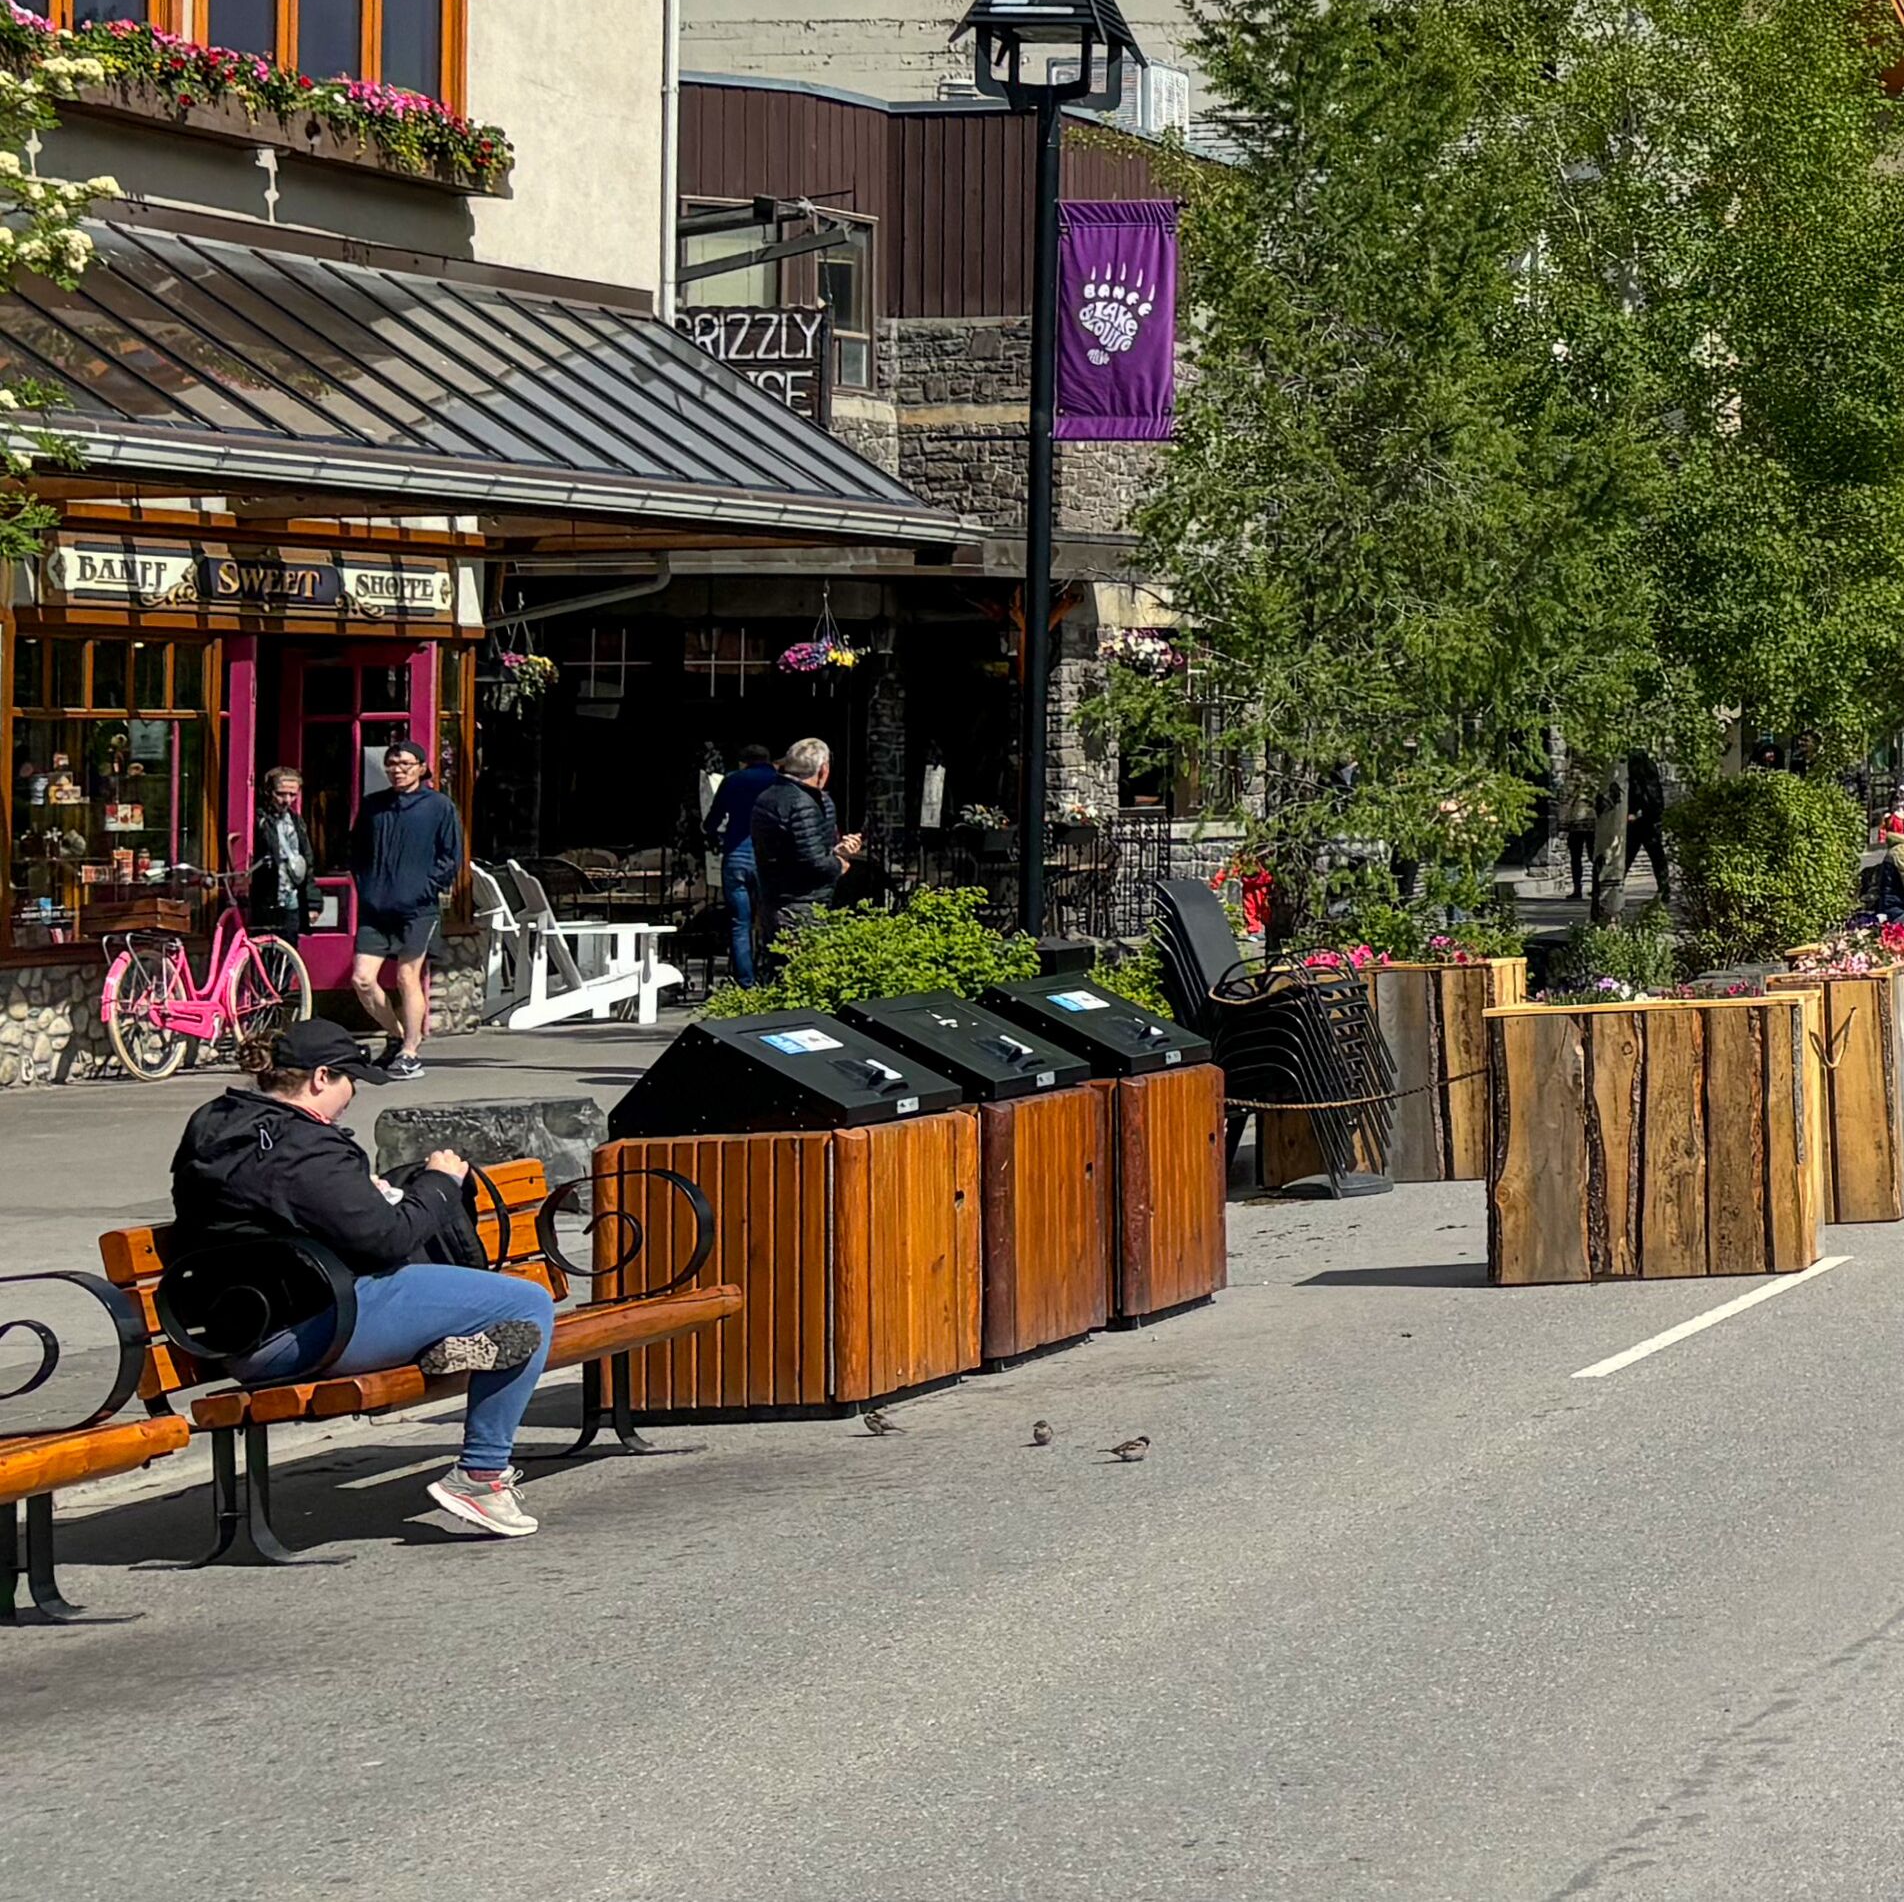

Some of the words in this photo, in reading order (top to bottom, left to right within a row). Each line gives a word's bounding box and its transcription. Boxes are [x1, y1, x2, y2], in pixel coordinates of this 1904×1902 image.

[1083, 283, 1153, 317] BANFF
[76, 555, 167, 592] BANFF
[217, 563, 321, 599] SWEET
[356, 573, 434, 604] SHOPPE
